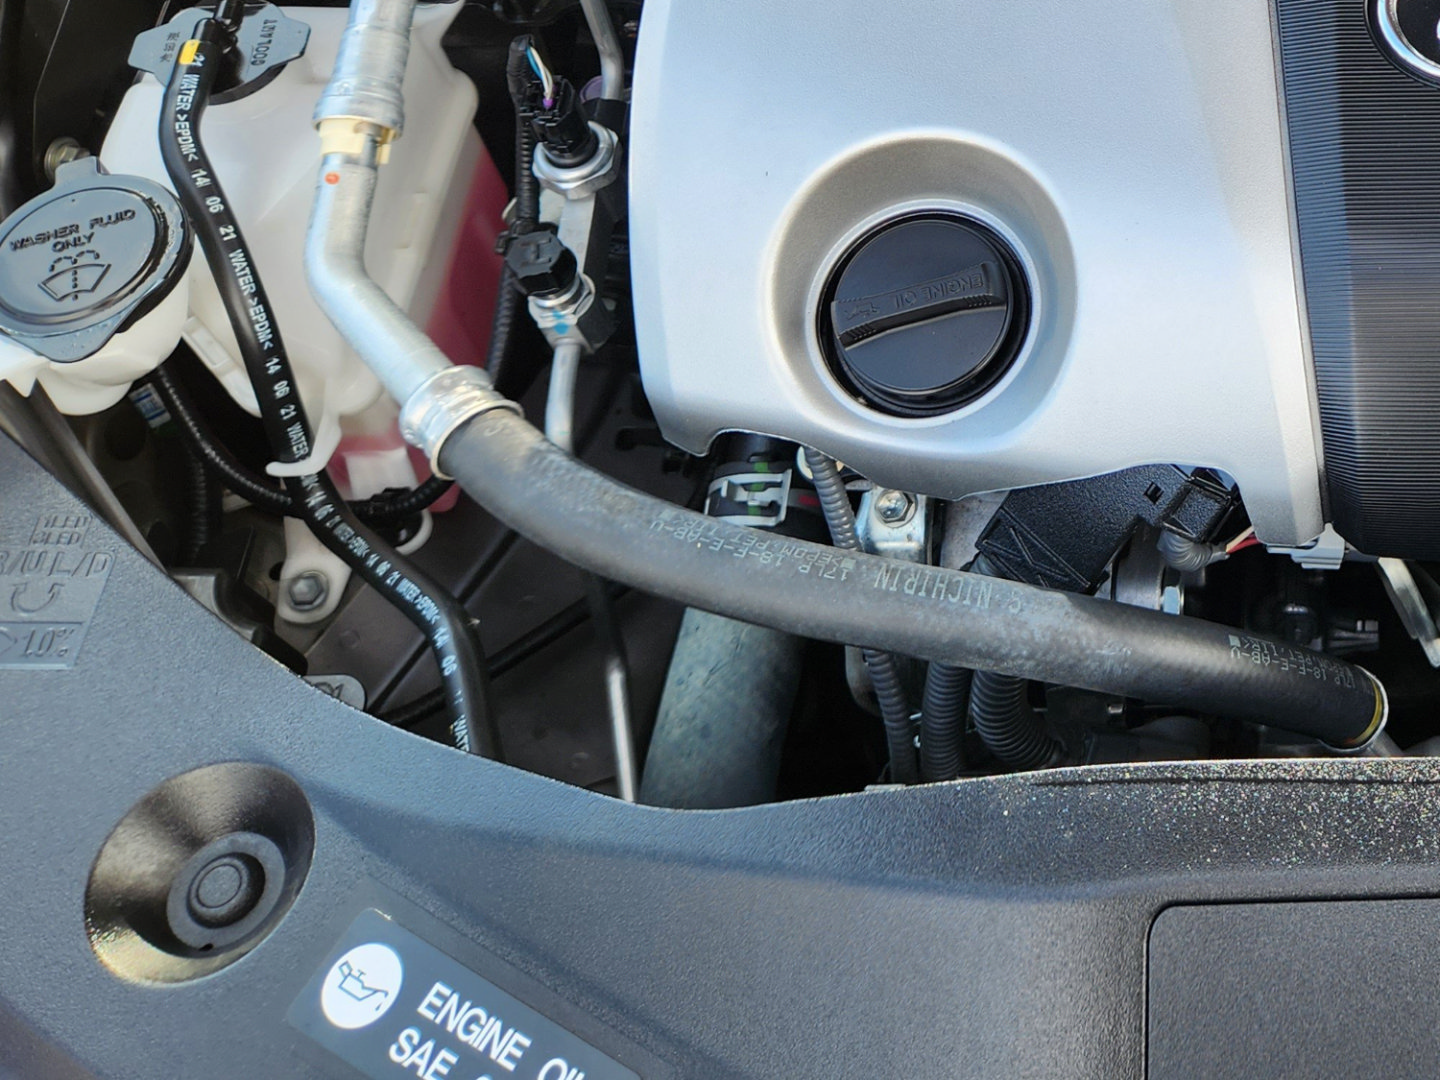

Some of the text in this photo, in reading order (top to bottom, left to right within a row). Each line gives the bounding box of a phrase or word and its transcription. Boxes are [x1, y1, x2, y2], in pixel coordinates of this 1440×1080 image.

[175, 73, 200, 111] WATER
[175, 114, 199, 162] >EPDM<
[192, 168, 211, 188] 14
[205, 196, 224, 213] 06
[9, 223, 81, 252] WASHER
[89, 208, 137, 231] FLUID
[51, 231, 95, 253] ONLY
[219, 224, 237, 241] 21
[229, 248, 256, 296] WATER
[924, 272, 984, 297] ENGINE
[248, 297, 274, 350] >EPDM<
[265, 356, 282, 374] 14
[273, 380, 290, 399] 06
[280, 404, 297, 420] 21
[287, 421, 309, 458] WATER
[874, 562, 993, 609] NICHIRIN
[396, 576, 421, 603] WATER
[441, 654, 458, 676] 06
[416, 981, 533, 1072] ENGINE
[388, 1025, 460, 1080] SAE
